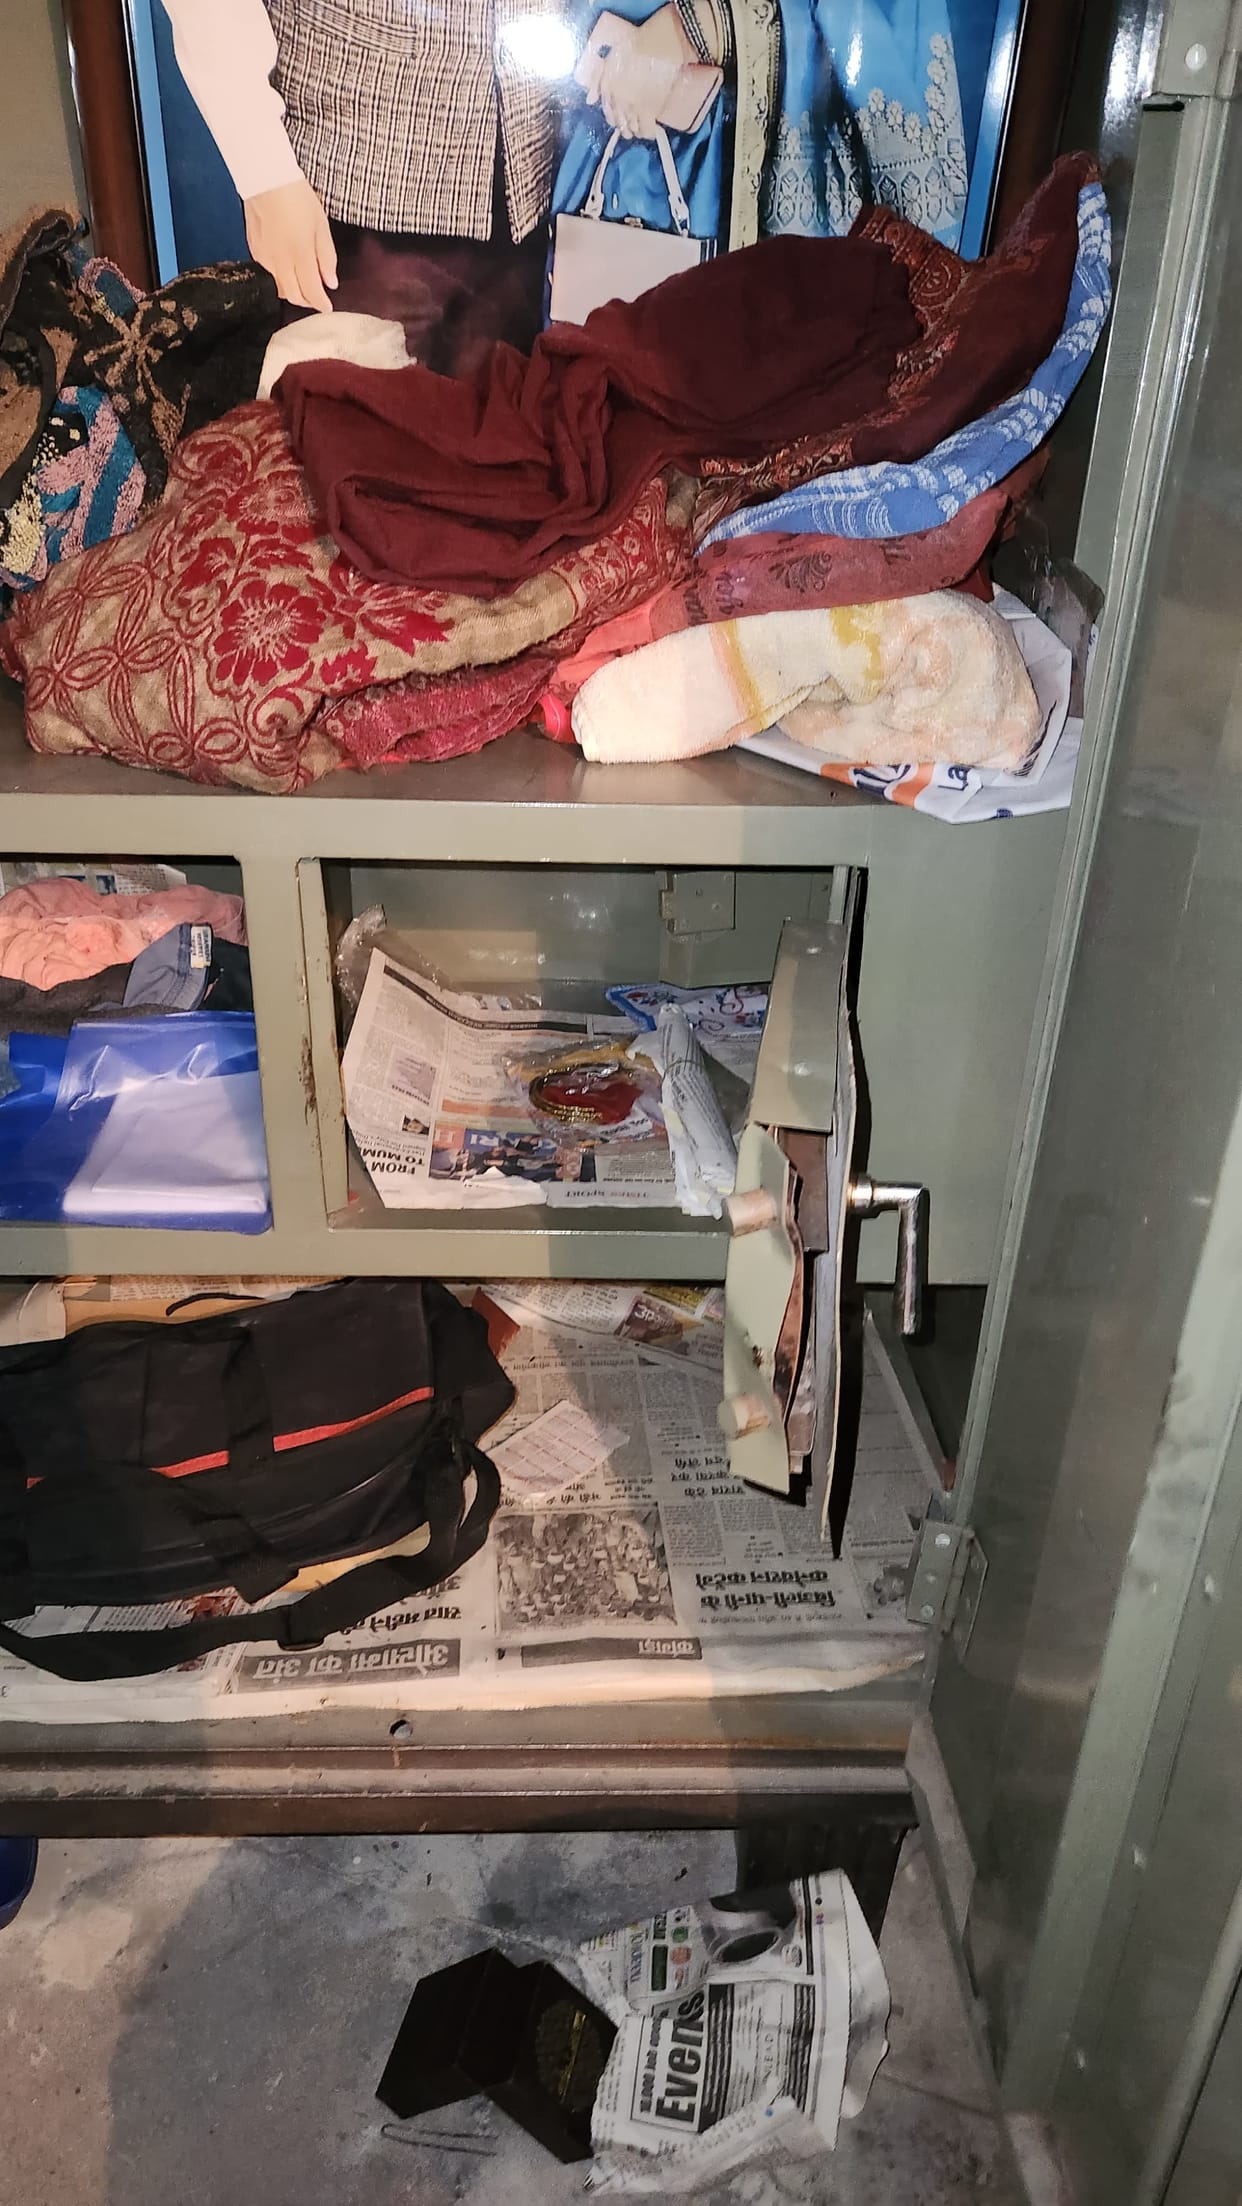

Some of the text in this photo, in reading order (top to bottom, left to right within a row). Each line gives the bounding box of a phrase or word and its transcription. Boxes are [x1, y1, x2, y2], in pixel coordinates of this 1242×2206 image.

[370, 1161, 416, 1176] FROM
[405, 1156, 425, 1167] TO
[423, 1606, 462, 1622] सात
[370, 1613, 421, 1634] महीने
[252, 1643, 449, 1685] ओसामा का अंत
